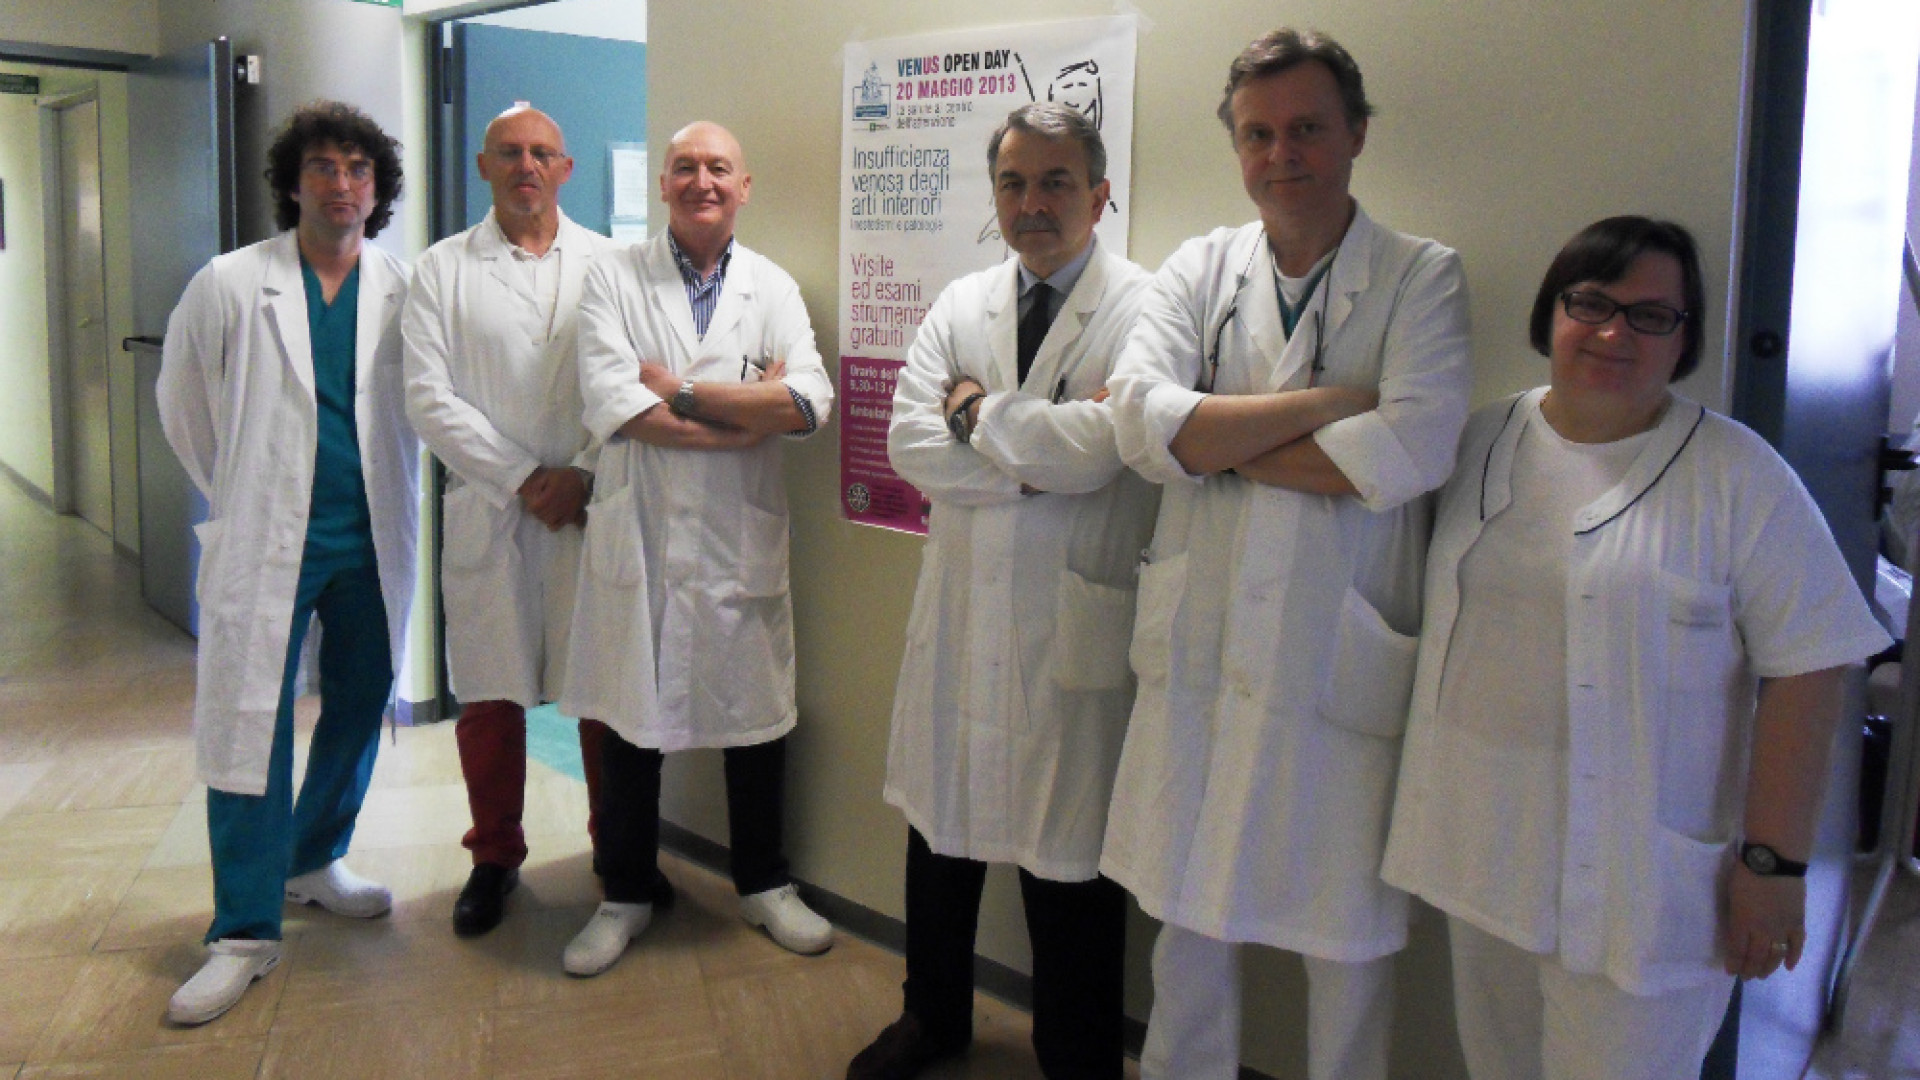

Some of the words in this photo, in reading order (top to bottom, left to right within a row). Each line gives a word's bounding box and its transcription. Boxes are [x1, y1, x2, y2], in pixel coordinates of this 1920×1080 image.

[897, 55, 939, 77] VENUS
[944, 51, 980, 74] OPEN
[984, 49, 1010, 70] DAY
[896, 82, 912, 100] 20
[917, 77, 973, 98] MAGGIO
[978, 73, 1016, 94] 2013
[853, 144, 949, 169] Insufficienza
[852, 172, 903, 192] venosa
[909, 168, 949, 196] degli
[852, 192, 876, 216] arti
[882, 191, 942, 216] inferiori
[850, 252, 893, 277] Visite
[851, 278, 870, 300] ed
[875, 278, 920, 301] esami
[850, 324, 903, 350] gratuiti
[850, 363, 878, 379] Orario
